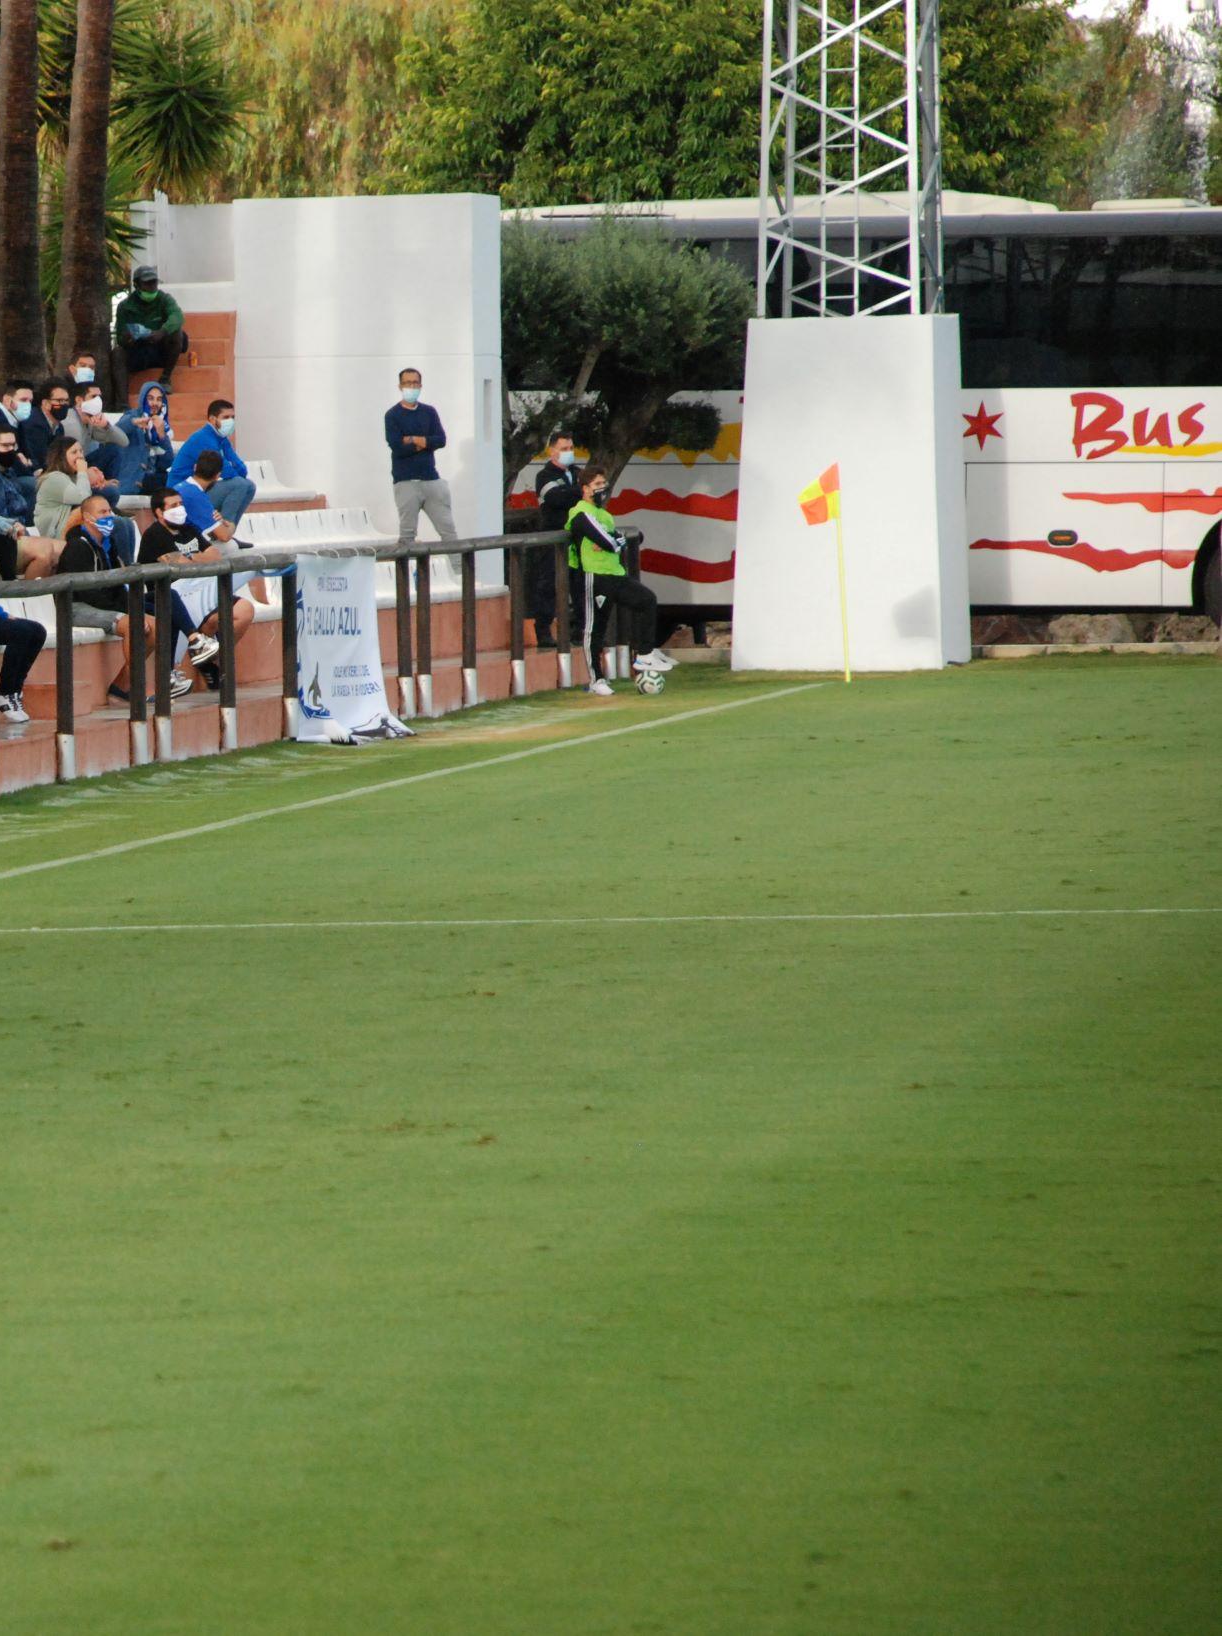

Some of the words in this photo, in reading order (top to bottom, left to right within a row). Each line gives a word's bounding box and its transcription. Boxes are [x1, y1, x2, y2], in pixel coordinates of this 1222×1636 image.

[1070, 391, 1206, 460] Bus
[314, 606, 336, 636] GALLO
[338, 606, 362, 636] AZUL
